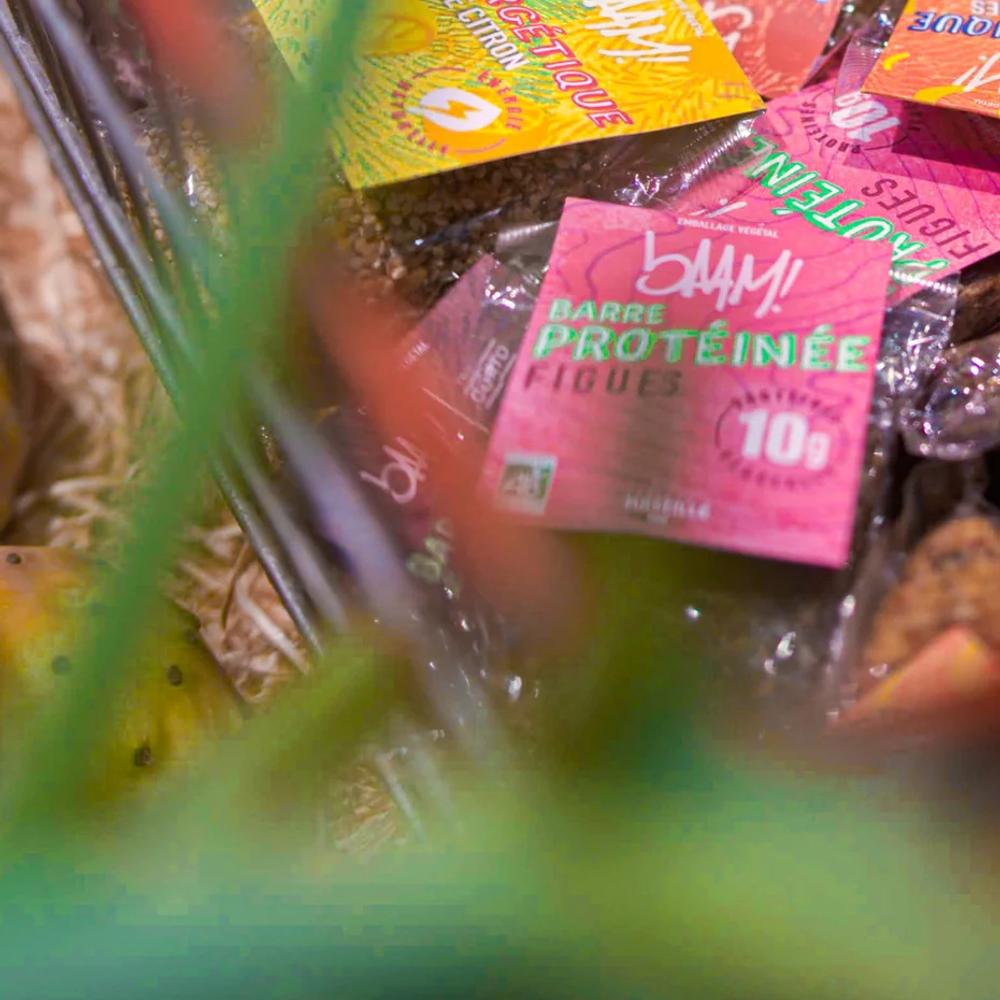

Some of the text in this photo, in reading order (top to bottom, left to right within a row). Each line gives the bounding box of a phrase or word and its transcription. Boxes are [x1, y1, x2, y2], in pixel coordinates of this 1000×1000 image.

[457, 4, 533, 73] CITRON
[676, 217, 735, 234] EMBALLAGE
[861, 177, 993, 260] FIGUES
[547, 299, 666, 325] BARRE
[532, 320, 870, 373] PROTÉINÉE
[521, 366, 683, 397] FIGUES
[738, 407, 830, 471] 10g
